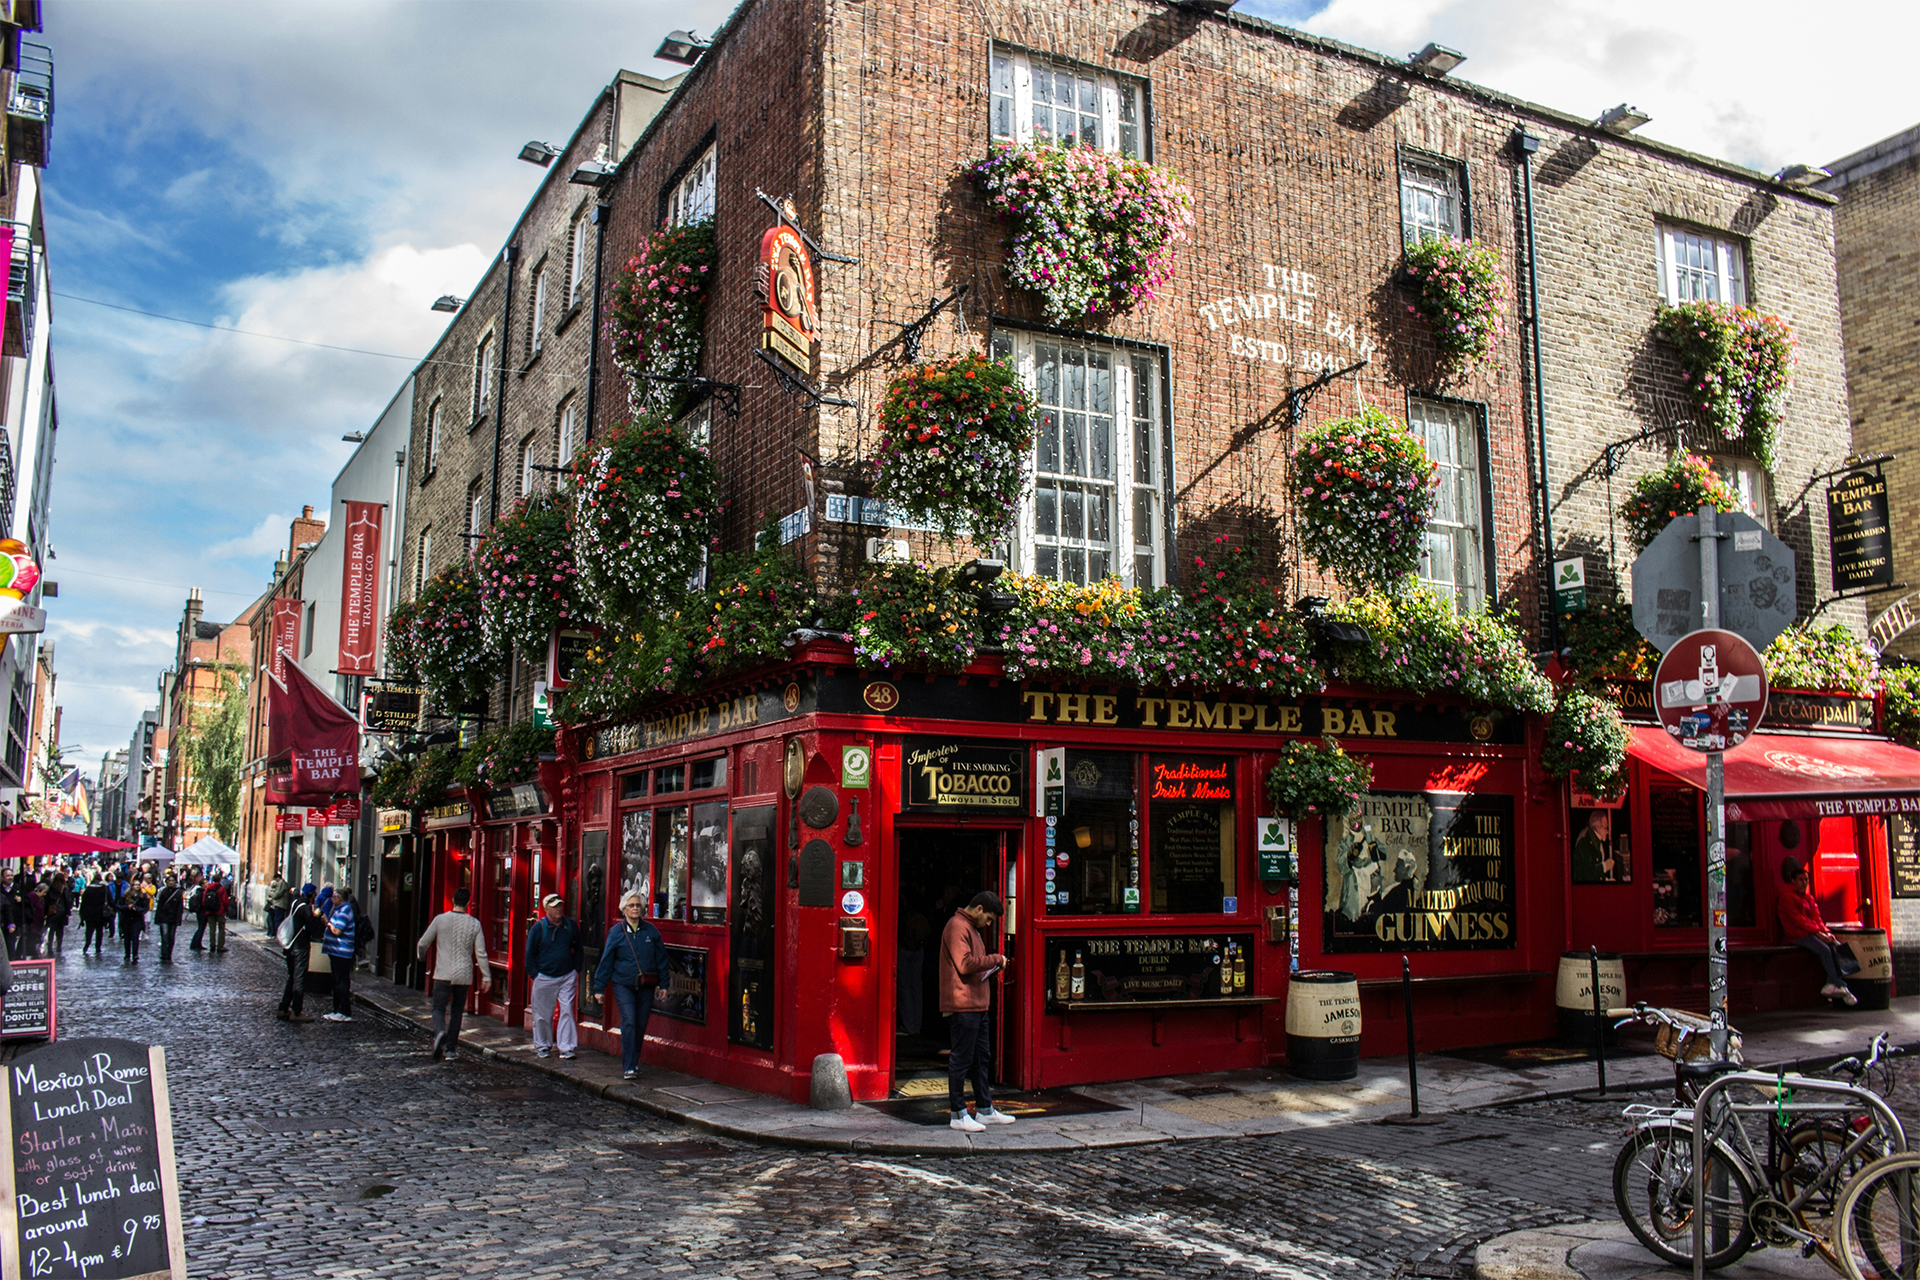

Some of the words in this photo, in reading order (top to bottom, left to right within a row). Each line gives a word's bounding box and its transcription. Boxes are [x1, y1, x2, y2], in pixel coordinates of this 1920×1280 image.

[1262, 263, 1318, 299] THE
[1198, 293, 1315, 332] TEMPLE
[1324, 308, 1377, 364] BAR
[1230, 333, 1292, 366] ESTD.
[1846, 475, 1865, 488] THE
[1829, 482, 1885, 505] TEMPLE
[1843, 499, 1873, 516] BAR
[1833, 532, 1854, 543] BEER
[1854, 525, 1886, 540] GARDEN
[352, 532, 364, 560] BAR
[365, 553, 374, 572] CO.
[1837, 562, 1857, 573] LIVE
[1857, 556, 1886, 569] MUSIC
[1848, 568, 1875, 580] DAILY
[349, 562, 363, 615] TEMPLE
[362, 574, 373, 628] TRADING
[285, 620, 295, 641] THE
[1872, 599, 1917, 647] THE
[347, 619, 360, 647] THE
[274, 633, 284, 674] TRDING
[870, 686, 892, 703] 48
[644, 706, 711, 747] TEMPLE
[718, 693, 759, 731] BAR
[1023, 691, 1119, 725] THE
[1136, 697, 1303, 732] TEMPLE
[1321, 707, 1398, 737] BAR
[295, 754, 354, 770] TEMPLE
[312, 748, 337, 758] THE
[907, 744, 959, 767] Importers
[939, 756, 949, 764] OF
[311, 768, 342, 780] BAR
[952, 762, 972, 771] FINE
[972, 763, 1011, 773] SMOKING
[1154, 762, 1228, 780] Traditional
[921, 766, 1012, 800] TOBACCO
[1151, 780, 1187, 799] Irish
[1192, 781, 1231, 799] Music
[939, 794, 974, 805] Always
[978, 795, 988, 804] in
[990, 795, 1019, 805] Stock
[1815, 800, 1845, 816] THE
[1845, 798, 1899, 815] TEMPLE
[1167, 809, 1201, 827] TEMPLE
[1203, 812, 1219, 828] BAR
[1359, 801, 1429, 818] TEMPLE
[1380, 818, 1412, 835] BAR
[1474, 815, 1501, 835] THE
[1442, 836, 1501, 857] EMPEROR
[1486, 860, 1501, 879] OF
[1406, 888, 1457, 911] MALTED
[1457, 880, 1507, 908] LIQUORS
[1374, 911, 1510, 943] GUINNESS
[1087, 940, 1120, 956] THE
[1123, 939, 1184, 955] TEMPLE
[1138, 955, 1170, 965] DUBLIN
[1122, 980, 1140, 989] LIVE
[1141, 980, 1162, 988] MUSIC
[1163, 979, 1184, 987] DAILY
[1579, 984, 1622, 998] JAESON
[1319, 997, 1333, 1007] THE
[4, 1012, 45, 1022] DONUTS
[14, 1063, 84, 1096] Mexico
[83, 1060, 98, 1086] to
[91, 1052, 149, 1085] Rome
[33, 1090, 91, 1122] Lunch
[91, 1084, 133, 1110] Deal
[20, 1125, 83, 1155] Starter
[101, 1115, 149, 1142] Main
[17, 1158, 41, 1173] with
[46, 1154, 82, 1173] glass
[89, 1148, 105, 1164] of
[113, 1144, 143, 1156] wine
[36, 1175, 51, 1186] or
[63, 1165, 95, 1181] soft
[105, 1160, 138, 1175] drink
[16, 1186, 70, 1219] Best
[75, 1177, 121, 1206] lunch
[129, 1168, 161, 1194] deal
[25, 1209, 89, 1240] around
